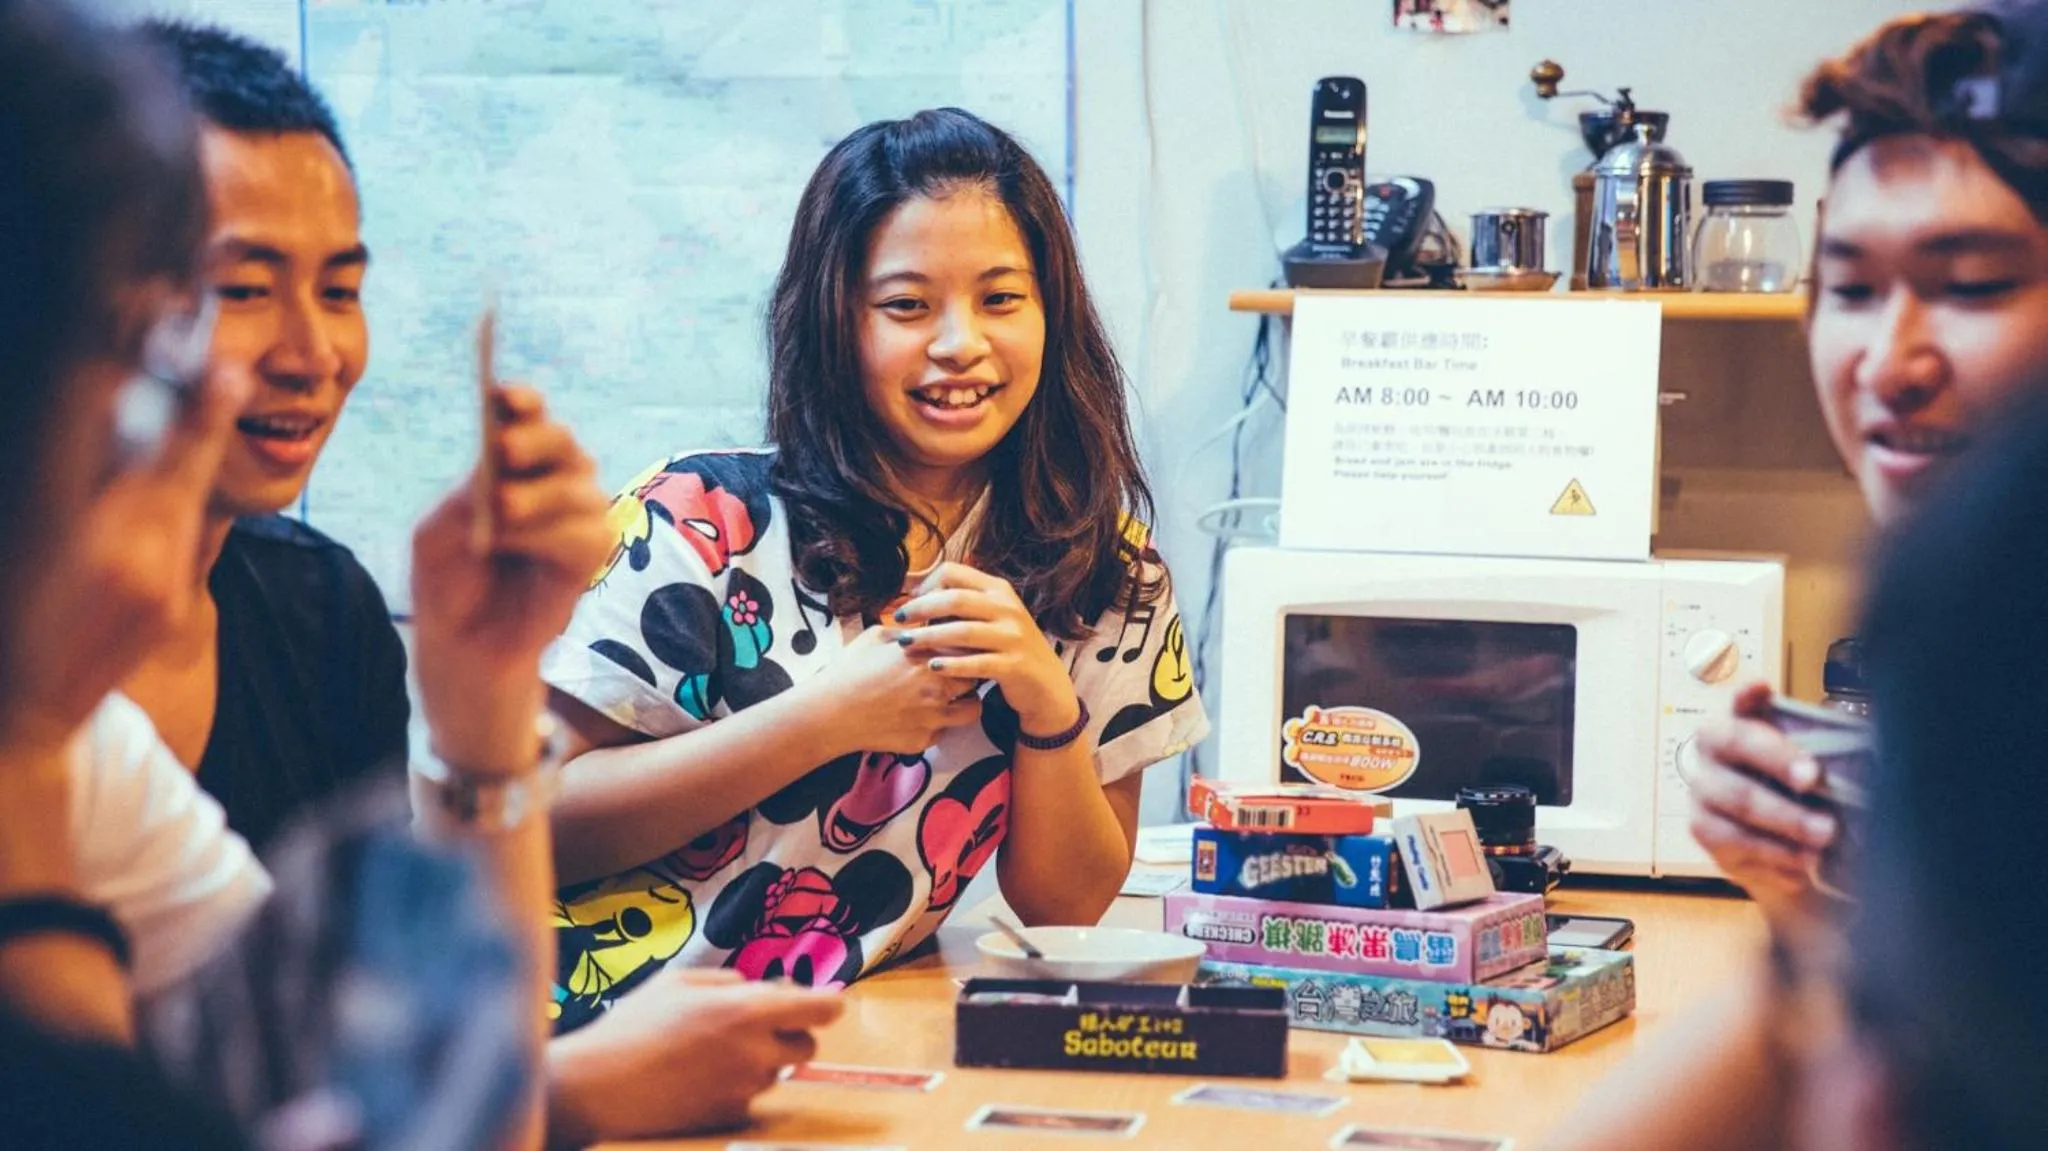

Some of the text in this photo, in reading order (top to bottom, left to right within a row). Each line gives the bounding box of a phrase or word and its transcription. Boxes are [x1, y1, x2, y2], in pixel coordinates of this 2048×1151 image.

[1341, 357, 1478, 371] Breakfast Bar Time
[1335, 387, 1372, 405] AM
[1381, 388, 1430, 406] 8:00
[1466, 389, 1505, 408] AM
[1516, 390, 1578, 409] 10:00
[1187, 924, 1252, 942] CHECKE
